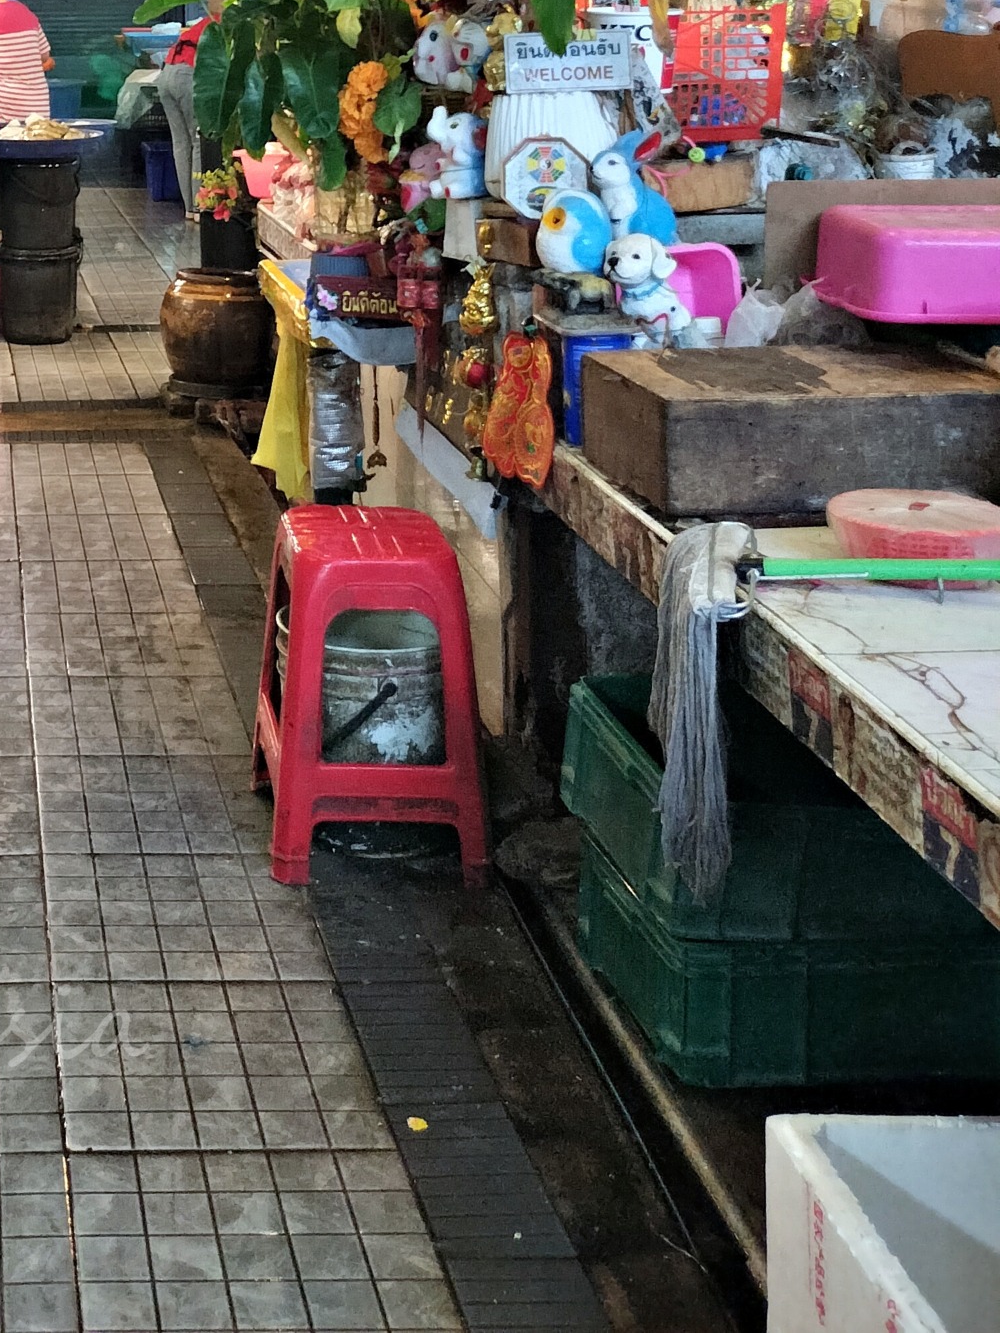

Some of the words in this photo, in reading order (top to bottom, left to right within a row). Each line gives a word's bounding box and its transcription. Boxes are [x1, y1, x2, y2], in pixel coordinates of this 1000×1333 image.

[524, 65, 614, 82] WELCOME
[342, 290, 398, 314] ยินดีต้อน
